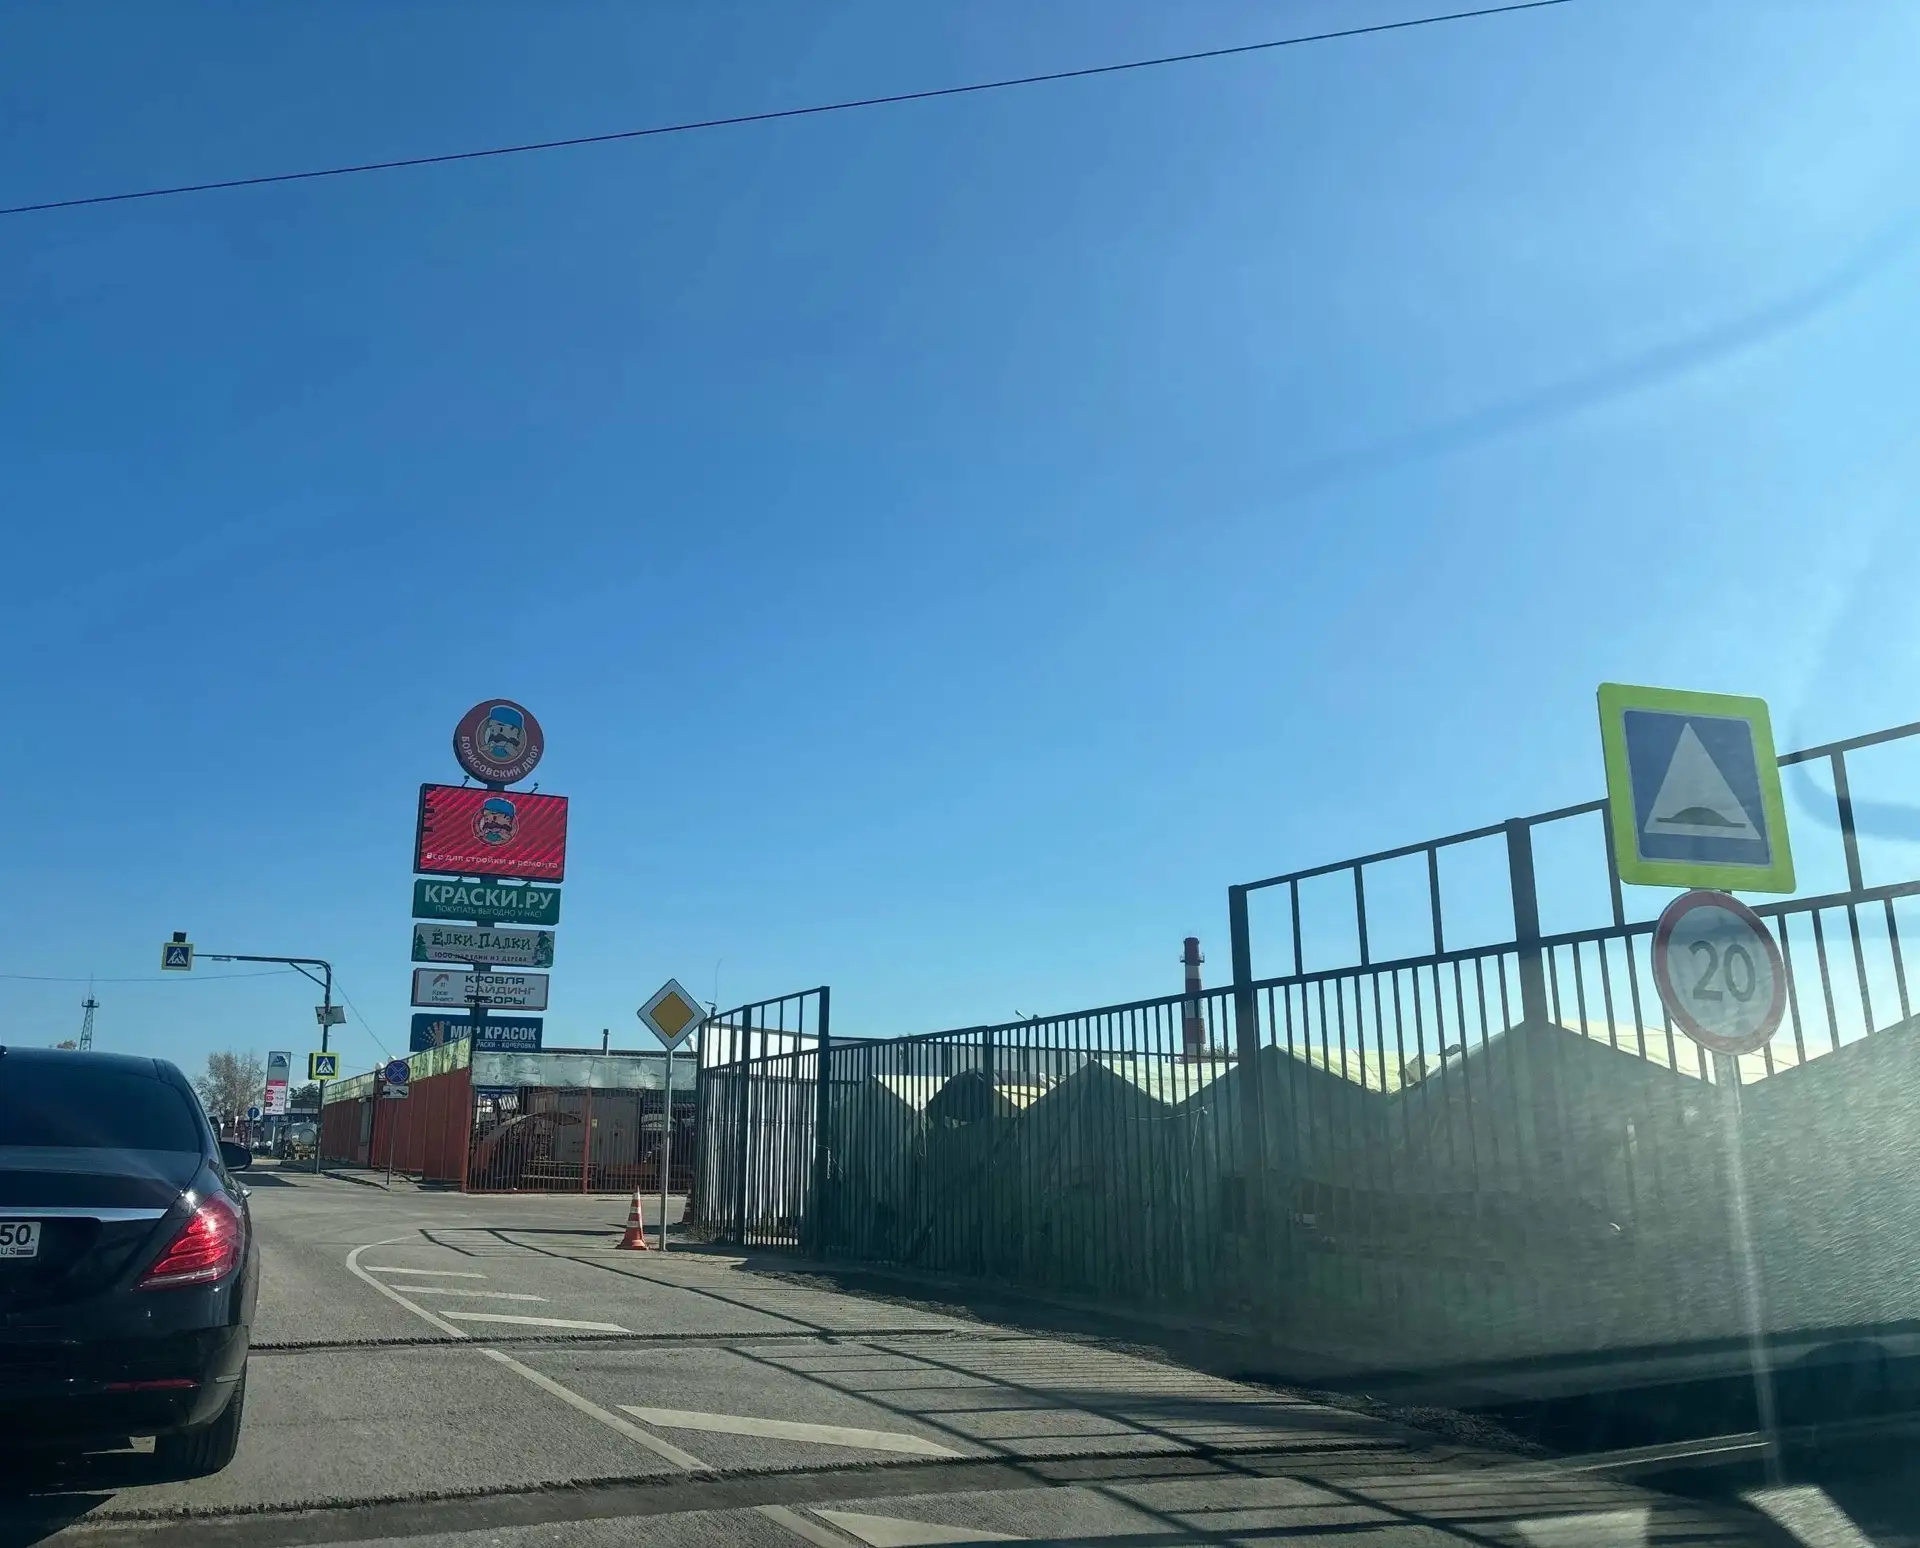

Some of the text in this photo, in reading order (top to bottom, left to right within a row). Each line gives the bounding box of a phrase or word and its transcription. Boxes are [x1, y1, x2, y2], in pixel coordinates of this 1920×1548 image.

[461, 736, 540, 778] БОРИСОВСКИЙ ДВОР
[466, 856, 506, 866] стройки
[517, 859, 558, 869] ремонта
[424, 884, 554, 910] КРАСКИ.РУ
[435, 904, 477, 915] ПОКУПАТЬ
[478, 907, 515, 917] ВЫГОДНО
[434, 951, 453, 959] 1000
[1689, 940, 1756, 1003] 20
[465, 976, 525, 985] КРОВЛЯ
[464, 985, 536, 996] САЙДИНГ
[485, 1026, 537, 1040] КРАСОК
[0, 1224, 31, 1246] 50
